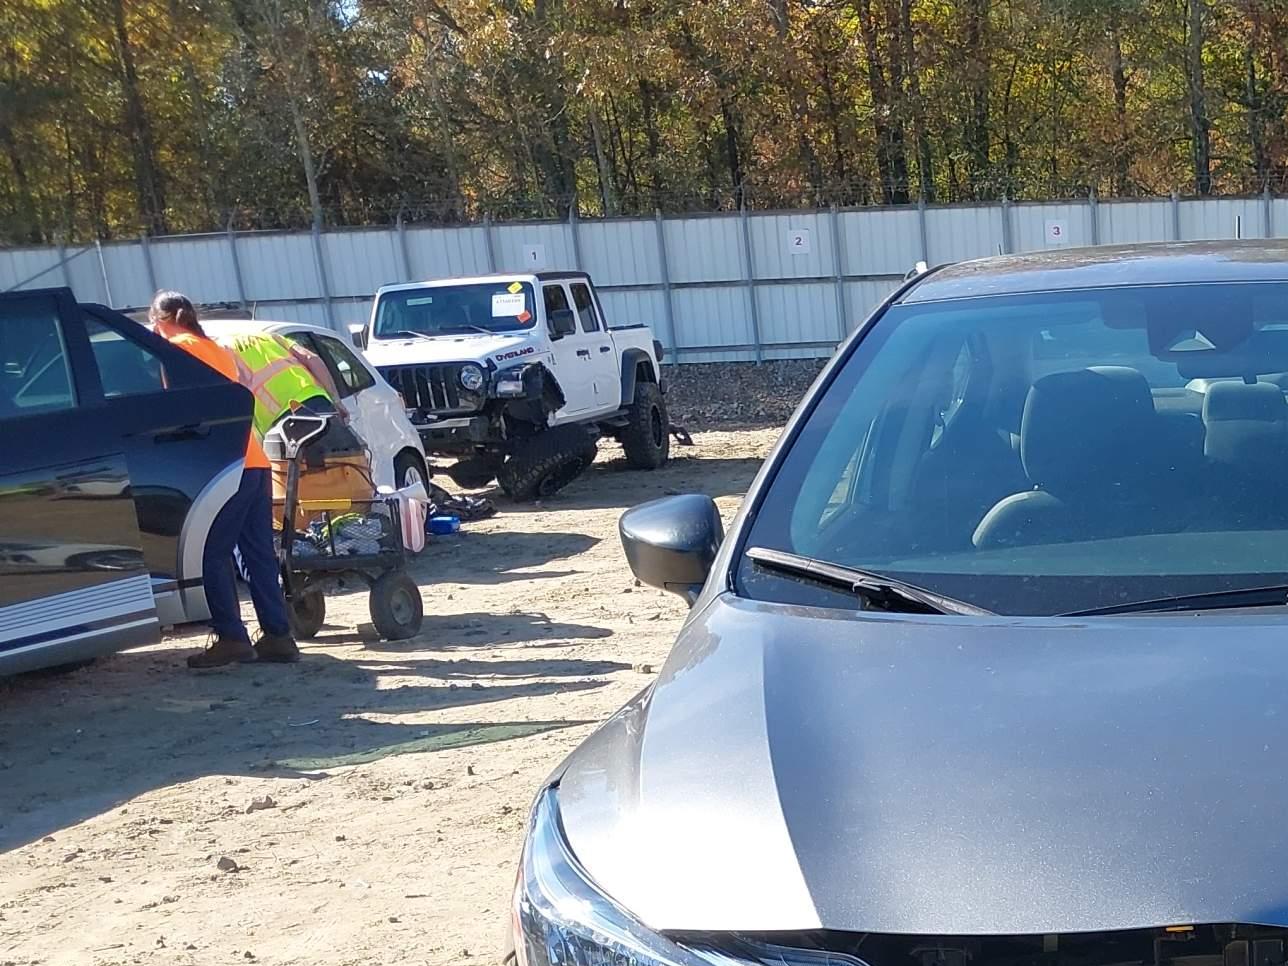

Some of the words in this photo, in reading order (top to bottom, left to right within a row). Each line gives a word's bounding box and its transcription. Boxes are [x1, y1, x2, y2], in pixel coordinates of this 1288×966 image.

[1052, 226, 1061, 236] 3
[795, 236, 802, 246] 2
[531, 251, 537, 261] 1
[495, 346, 535, 362] OVERLAND
